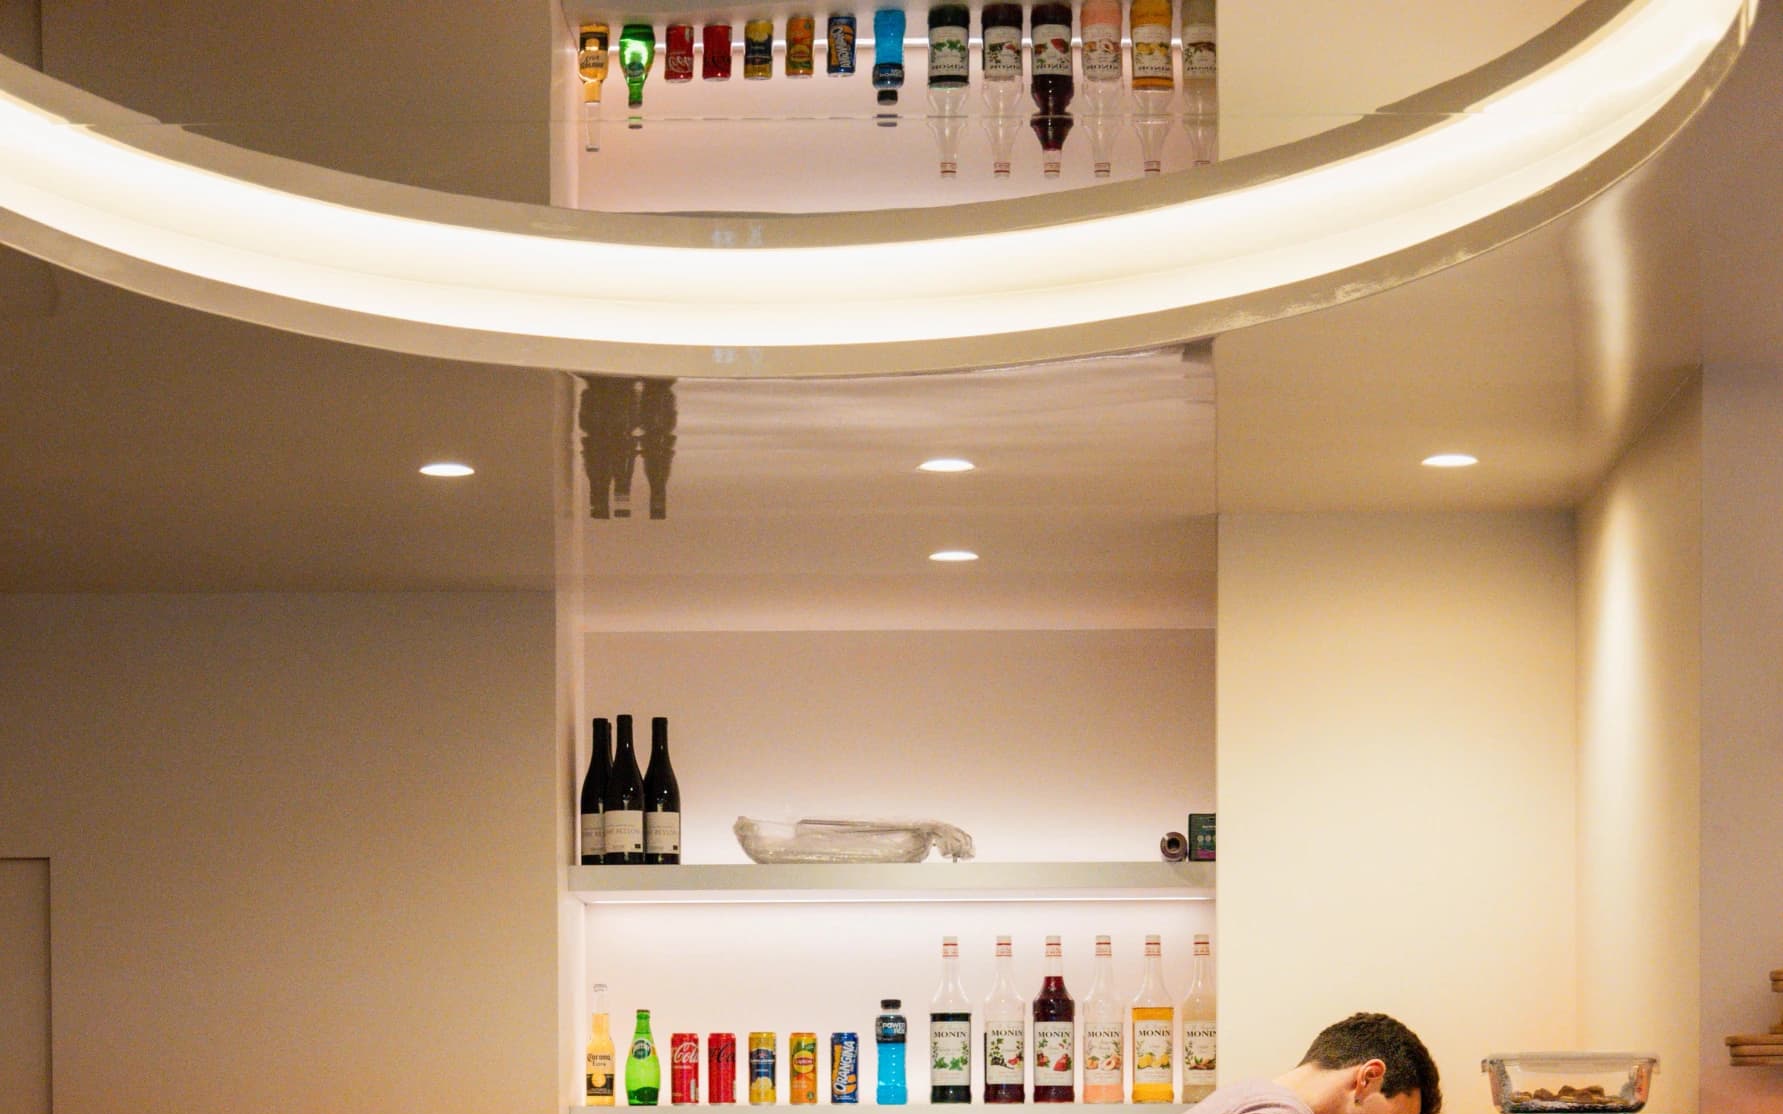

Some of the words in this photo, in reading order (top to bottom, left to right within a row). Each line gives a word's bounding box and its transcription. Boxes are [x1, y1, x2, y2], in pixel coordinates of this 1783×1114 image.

[933, 1030, 967, 1038] MONIN
[991, 1029, 1023, 1037] MONIN
[1038, 1030, 1071, 1038] MONIN
[1087, 1030, 1120, 1038] MONIN
[1138, 1029, 1171, 1037] MONIN
[833, 1040, 857, 1091] ORANGINA
